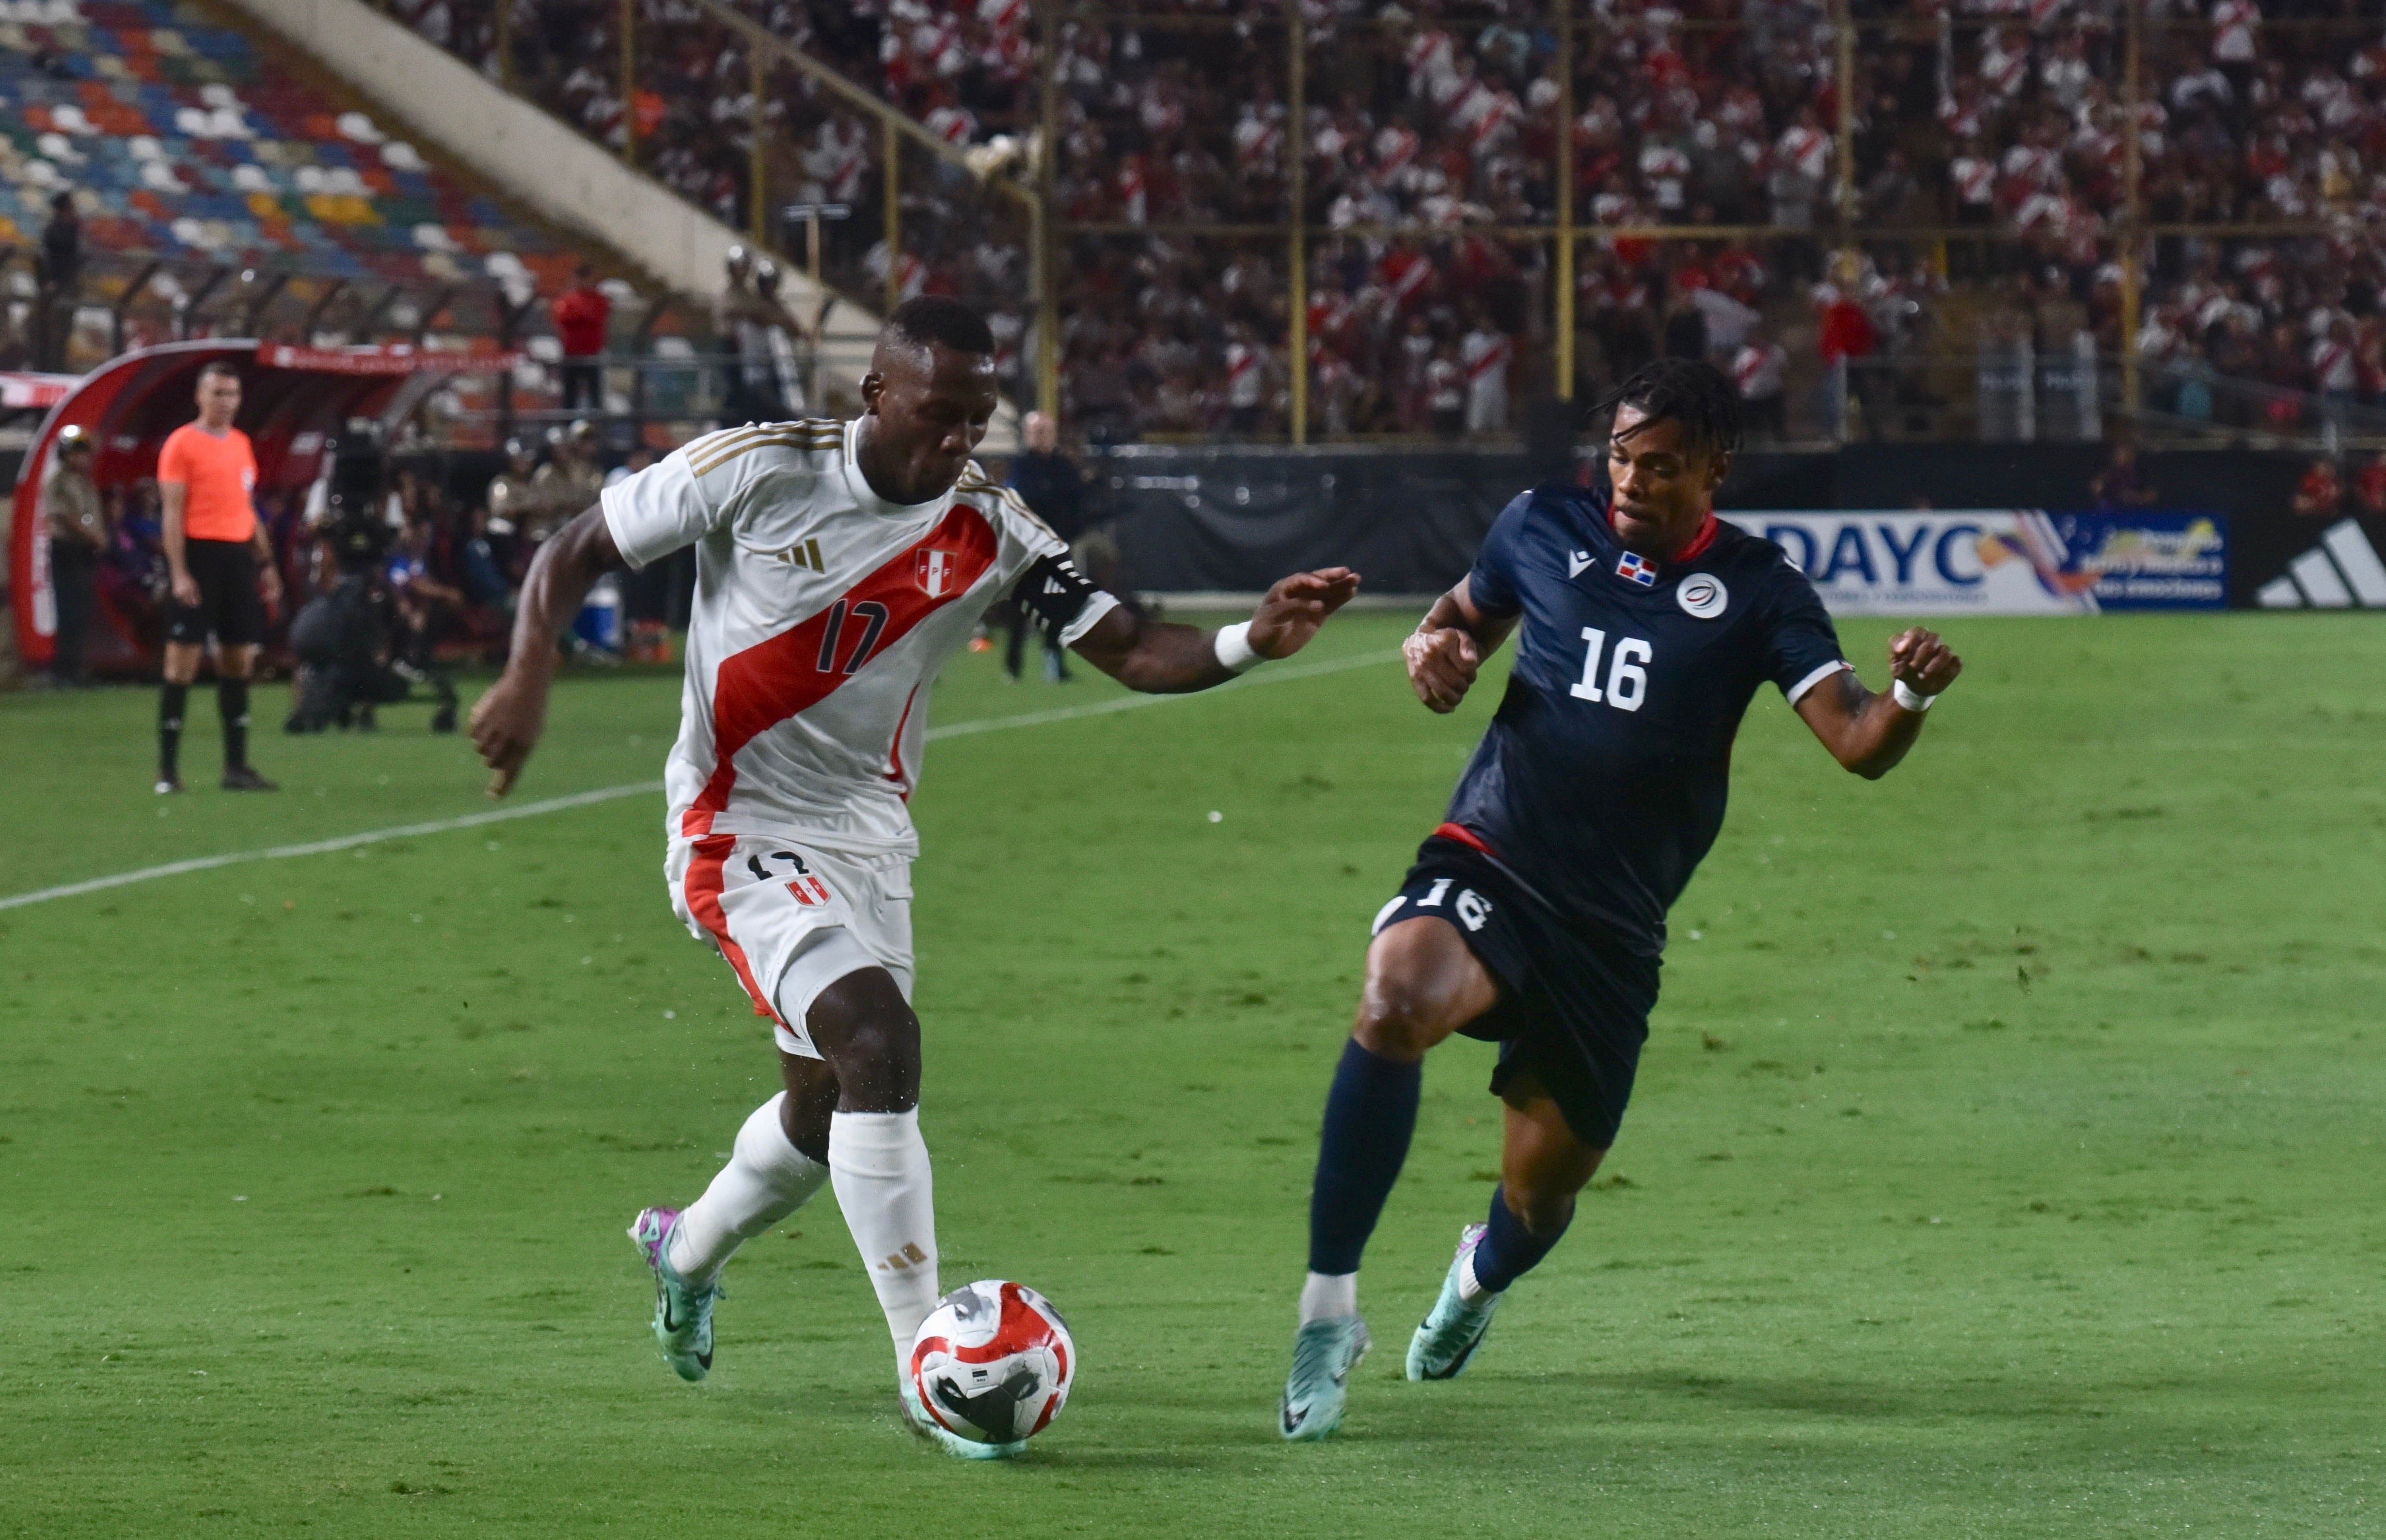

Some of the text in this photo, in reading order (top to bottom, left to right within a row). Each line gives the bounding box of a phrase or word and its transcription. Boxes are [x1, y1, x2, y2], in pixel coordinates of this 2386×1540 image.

[817, 598, 889, 674] 17
[1570, 627, 1652, 711] 16
[1417, 879, 1493, 931] 16
